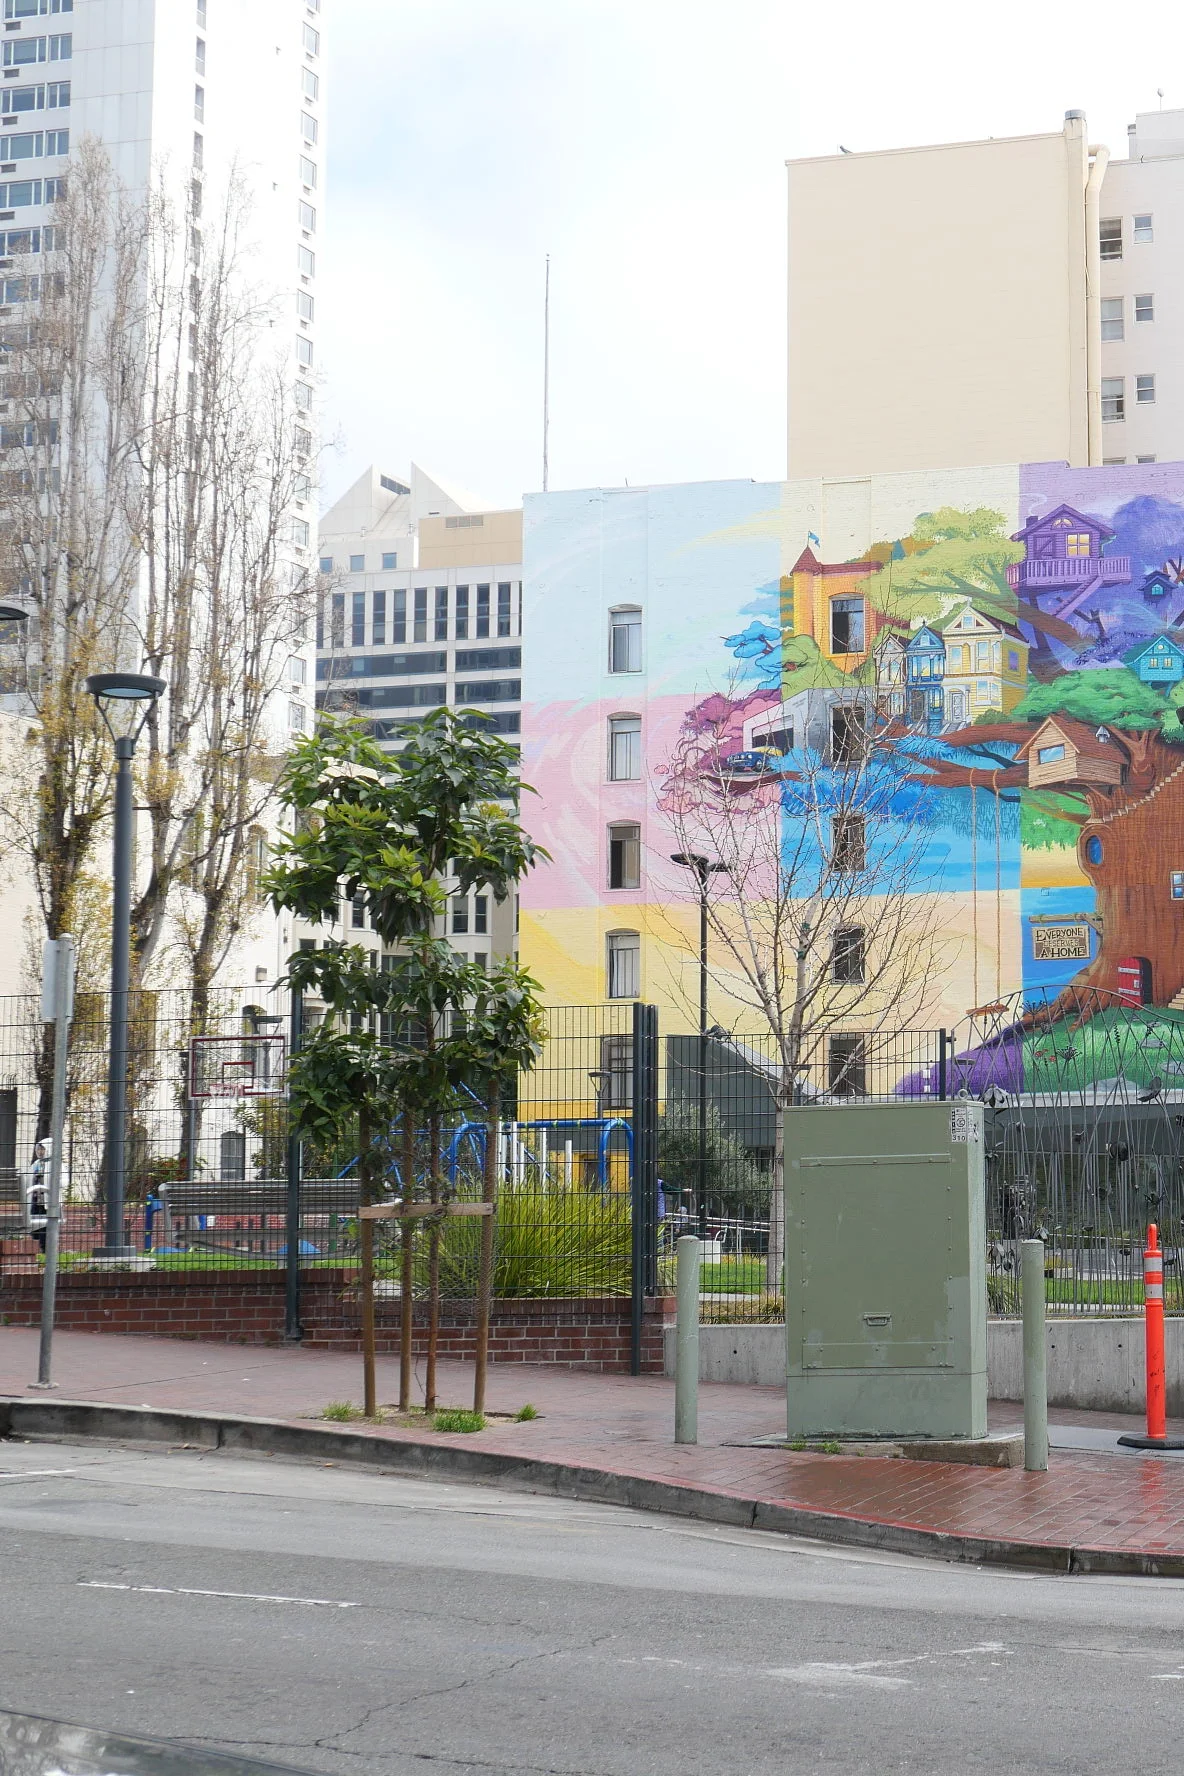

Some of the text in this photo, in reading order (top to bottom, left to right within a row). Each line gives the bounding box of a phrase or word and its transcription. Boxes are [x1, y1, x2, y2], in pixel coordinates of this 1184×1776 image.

[1035, 927, 1084, 942] EVERYONE
[1040, 946, 1086, 958] A HOME
